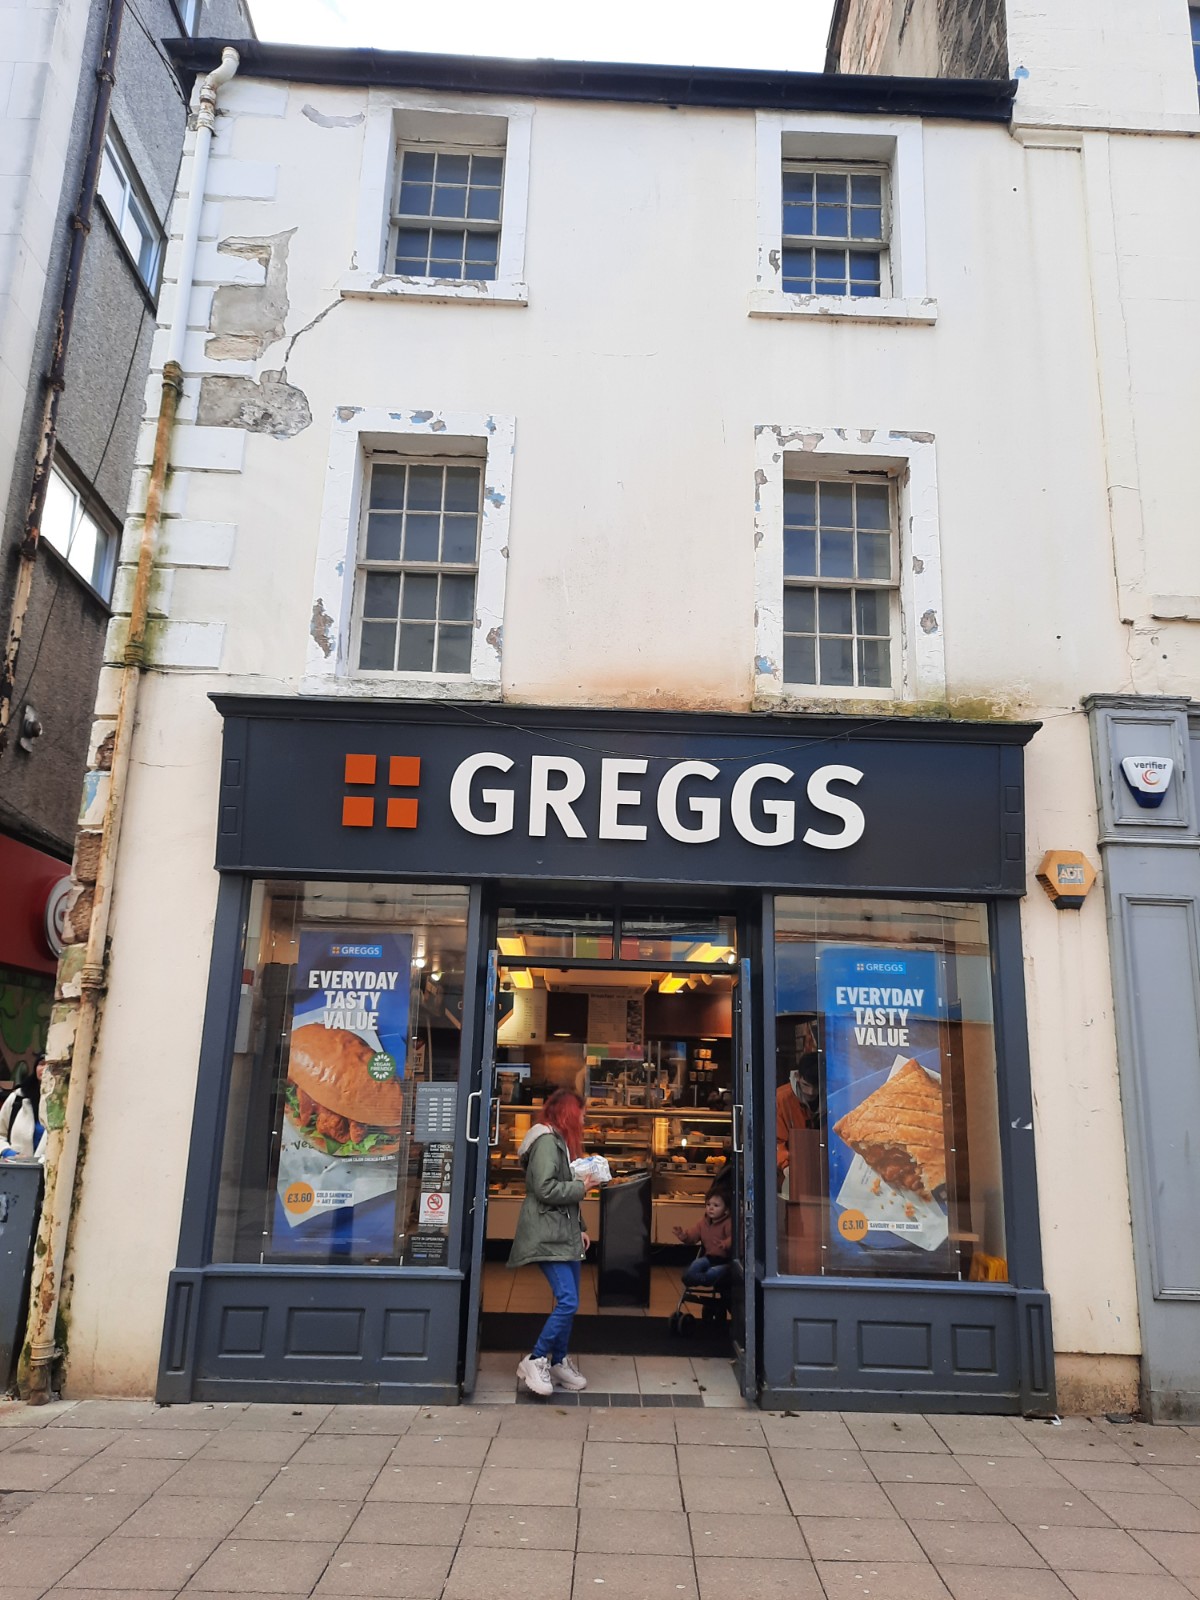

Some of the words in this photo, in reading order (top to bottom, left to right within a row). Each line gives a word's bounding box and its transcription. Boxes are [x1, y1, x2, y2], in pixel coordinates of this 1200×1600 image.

[1133, 761, 1168, 770] verifier
[449, 751, 866, 850] GREGGS
[1058, 867, 1083, 880] ADT
[341, 946, 380, 955] GREGGS
[866, 963, 904, 972] GREGGS
[308, 970, 399, 990] EVERYDAY
[323, 990, 381, 1010] TASTY
[836, 986, 925, 1007] EVERYDAY
[323, 1011, 379, 1031] VALUE
[853, 1007, 909, 1027] TASTY
[854, 1027, 910, 1047] VALUE
[287, 1192, 313, 1204] £3.60
[842, 1219, 865, 1230] £3.10
